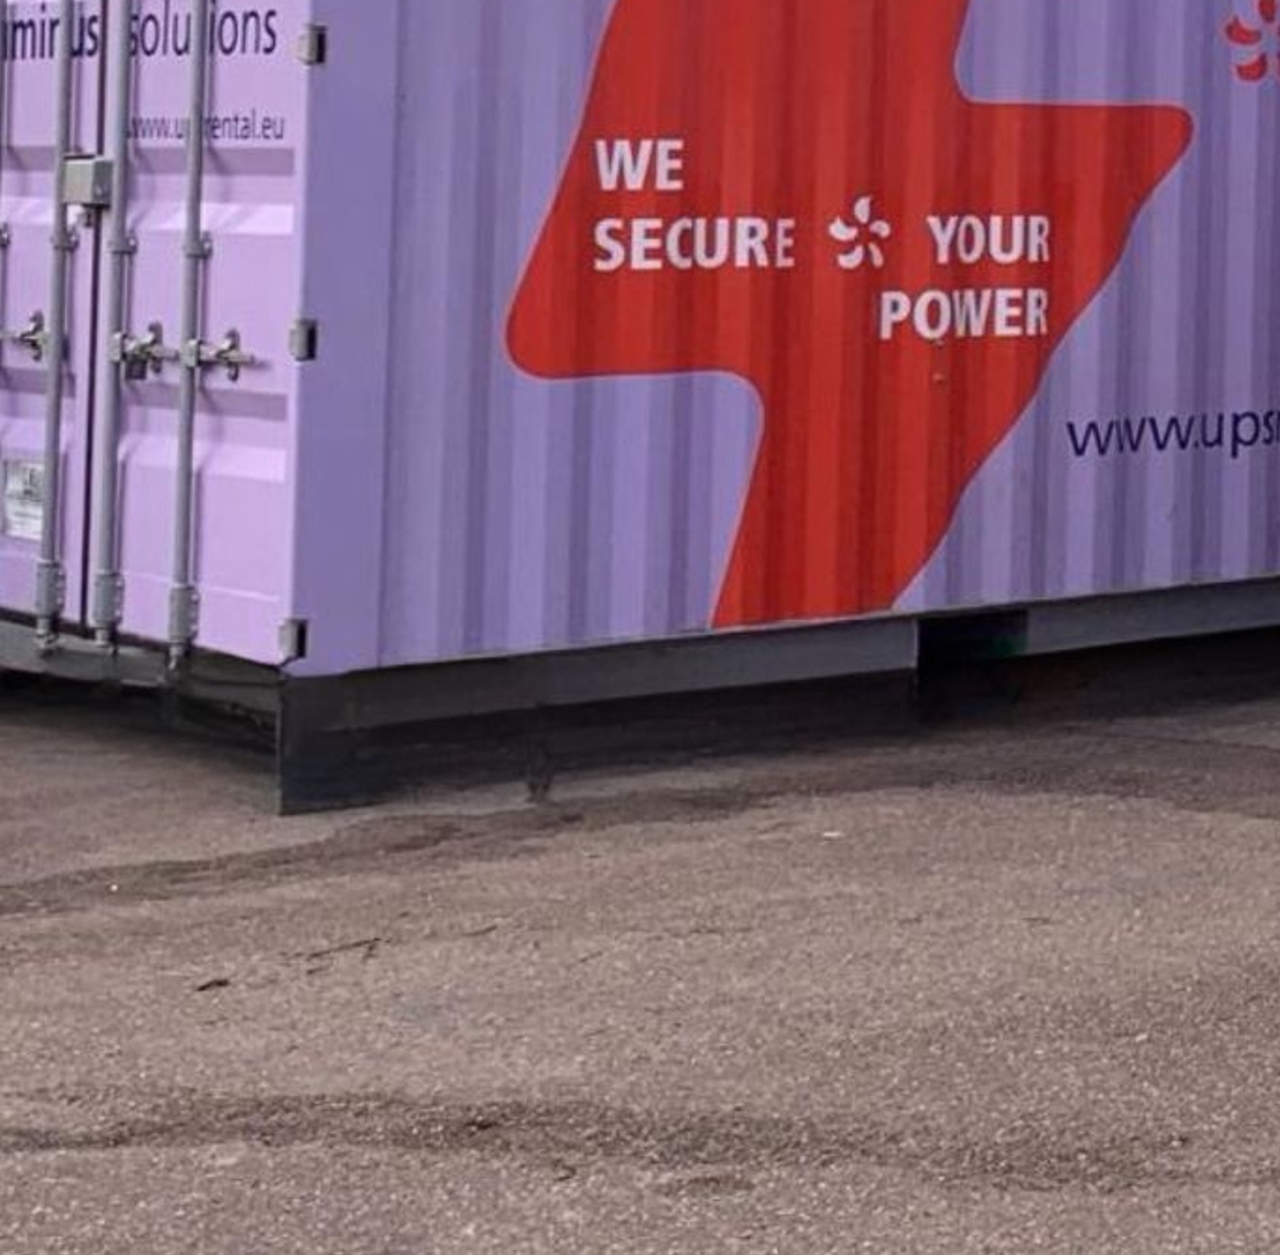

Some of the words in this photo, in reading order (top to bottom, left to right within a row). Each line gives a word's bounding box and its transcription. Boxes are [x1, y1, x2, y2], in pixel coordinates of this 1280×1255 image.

[595, 139, 684, 192] WE
[593, 217, 795, 271] SECURE
[927, 215, 1050, 264] YOUR
[880, 288, 1048, 341] POWER
